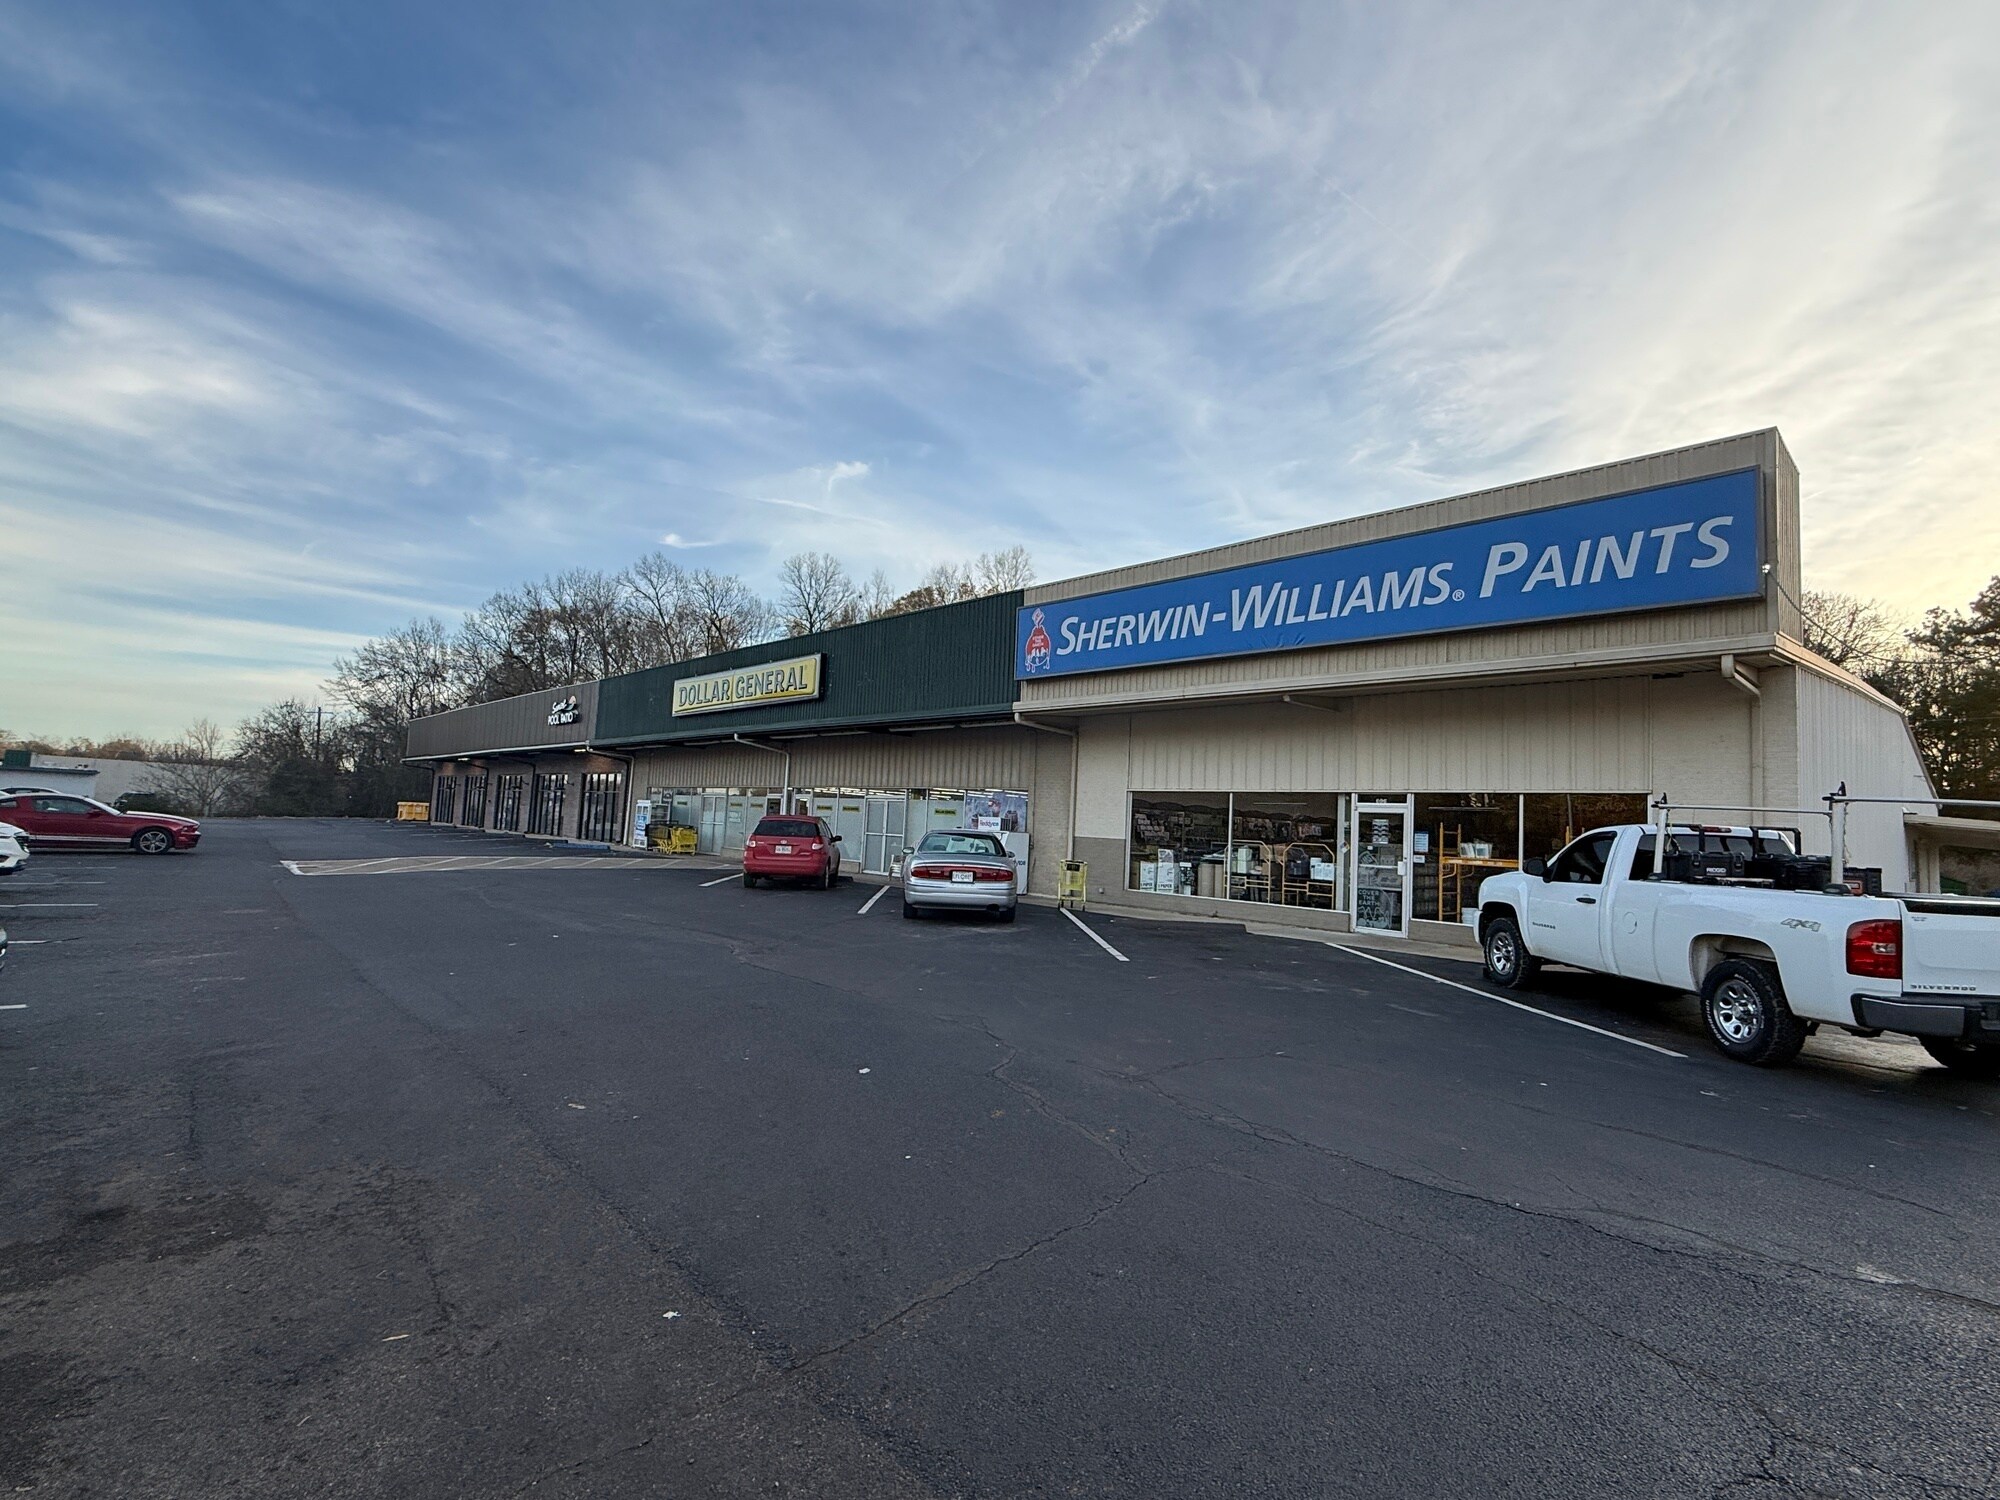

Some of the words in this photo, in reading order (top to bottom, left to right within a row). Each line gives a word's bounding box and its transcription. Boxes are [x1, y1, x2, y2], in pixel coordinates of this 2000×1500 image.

[1479, 515, 1733, 599] PAINTS
[679, 678, 731, 707] DOLLAR
[735, 665, 808, 699] GENERAL
[1910, 984, 1977, 992] SILVERADO
